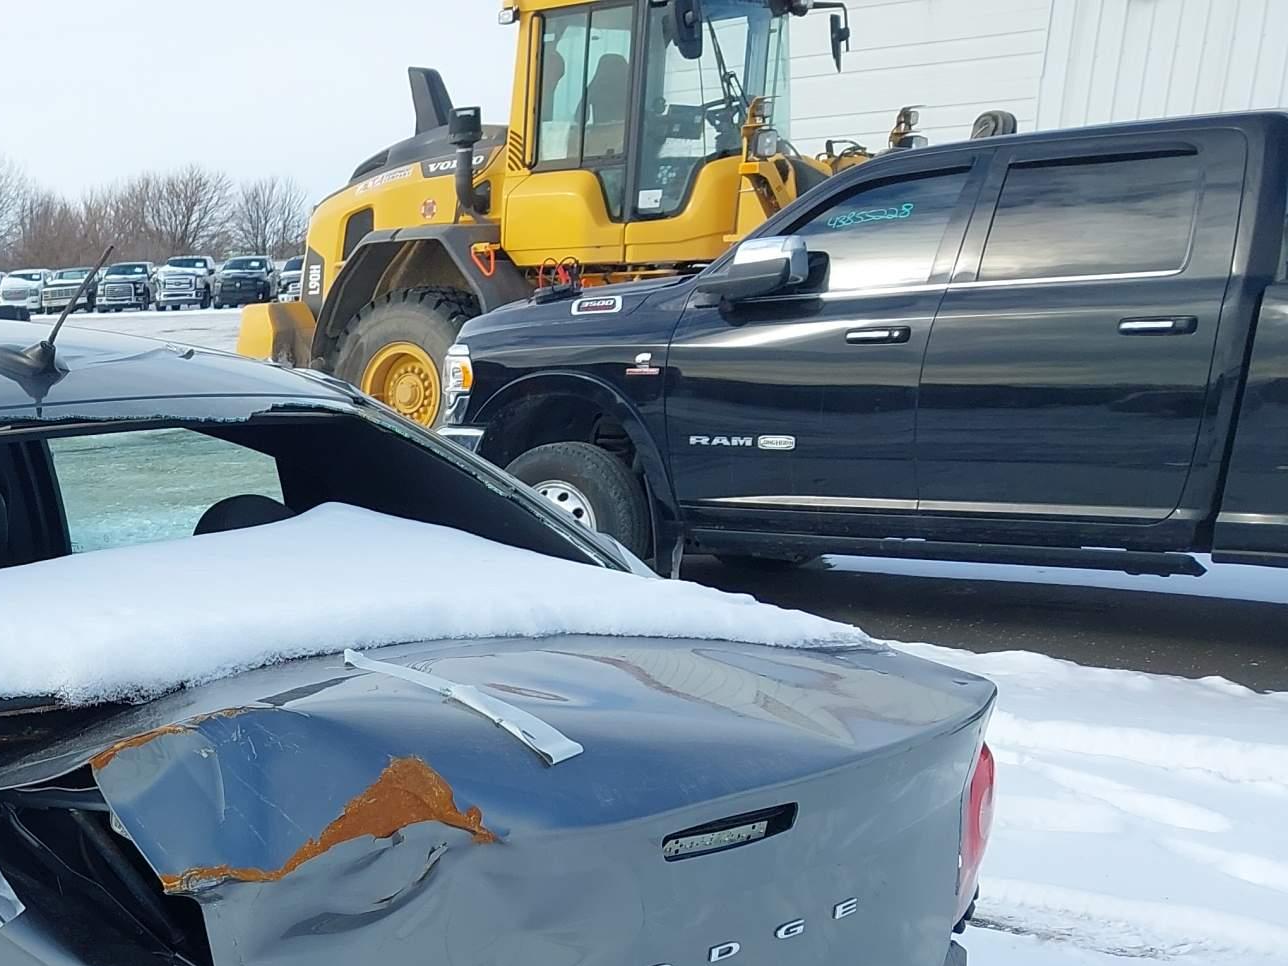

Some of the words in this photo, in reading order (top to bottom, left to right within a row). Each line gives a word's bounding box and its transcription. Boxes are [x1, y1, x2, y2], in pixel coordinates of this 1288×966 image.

[308, 264, 321, 295] L90H
[580, 299, 615, 308] 3500
[689, 435, 753, 446] RAM
